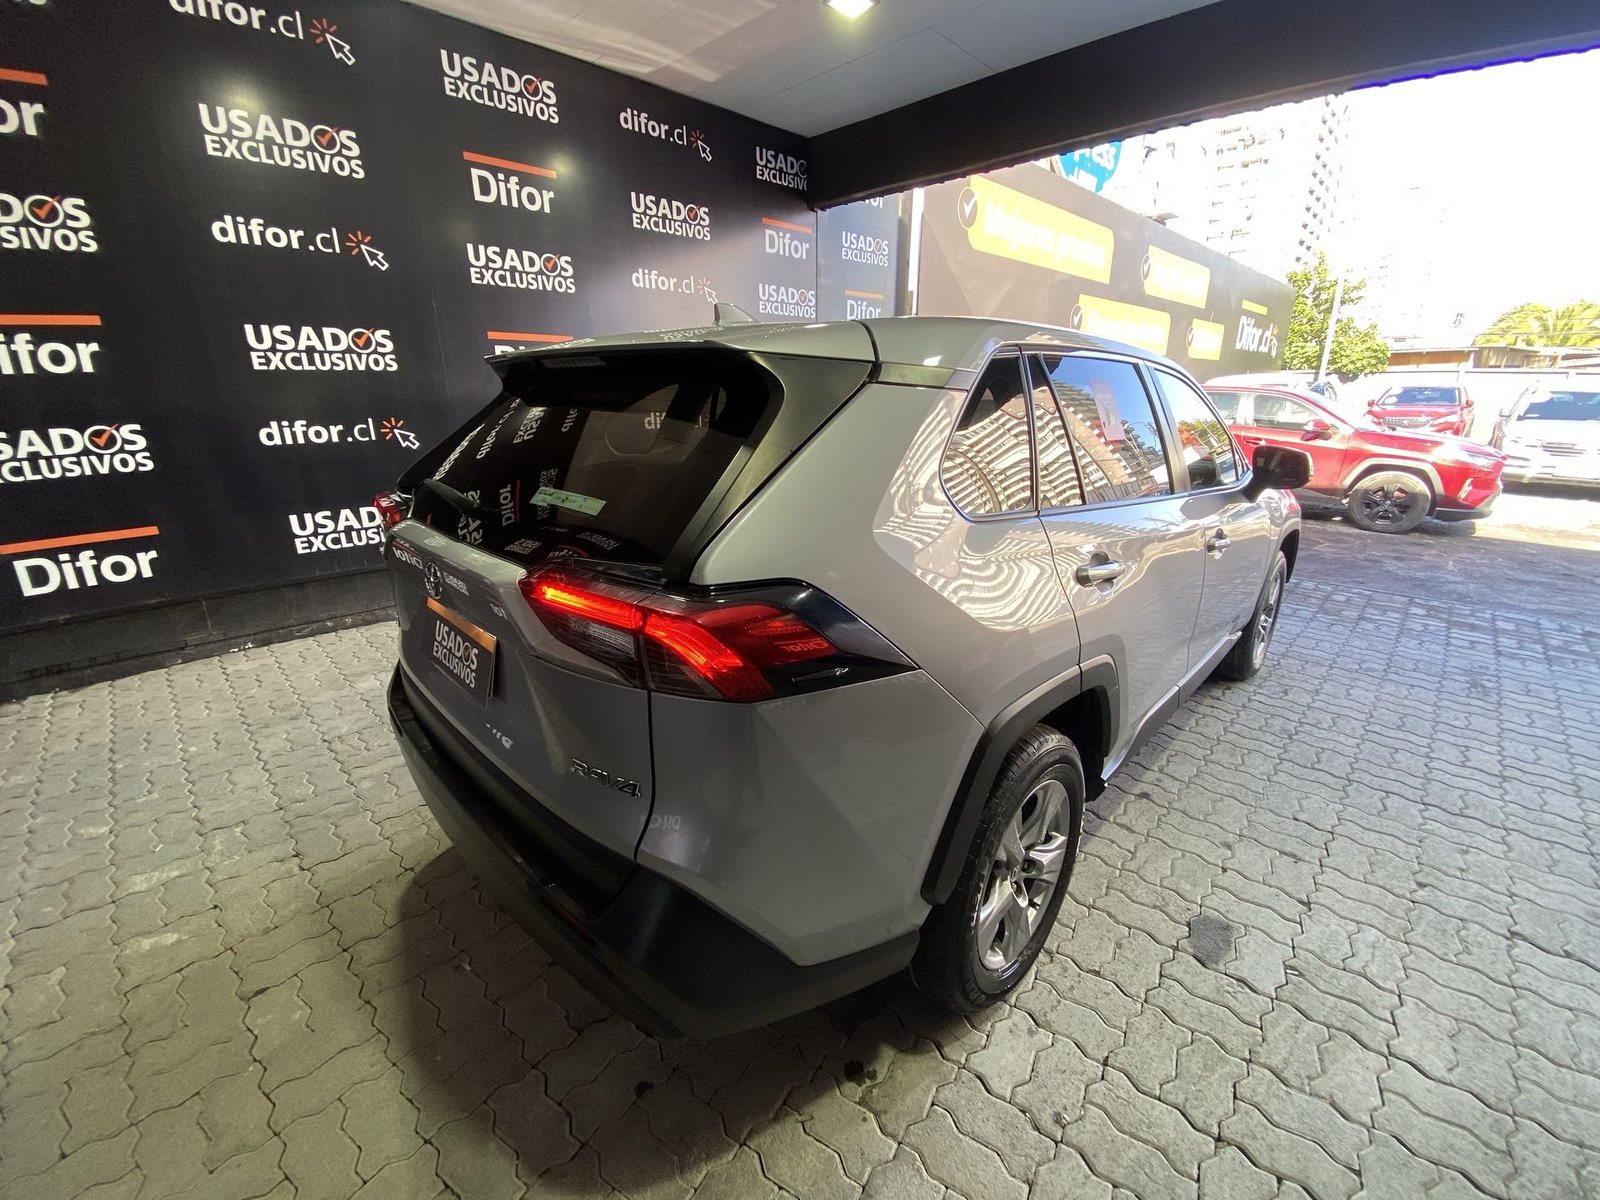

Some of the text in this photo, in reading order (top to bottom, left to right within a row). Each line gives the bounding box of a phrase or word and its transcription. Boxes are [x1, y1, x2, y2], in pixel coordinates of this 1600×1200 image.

[439, 48, 557, 104] USADOS
[444, 77, 559, 124] EXCLUSIVOS
[198, 103, 361, 157] USADOS
[619, 108, 688, 146] difor.cl
[204, 134, 365, 179] EXCLUSIVOS
[470, 167, 555, 213] Difor
[630, 191, 710, 226] USADOS
[211, 215, 341, 254] difor.cl
[632, 213, 711, 241] EXCLUSIVOS
[842, 231, 888, 255] USADOS
[466, 243, 573, 277] USADOS
[765, 229, 809, 260] Difor
[842, 249, 888, 267] EXCLUSIVOS
[469, 266, 576, 294] EXCLUSIVOS
[631, 268, 694, 294] difor.cl
[758, 283, 816, 306] USADOS
[759, 302, 816, 319] EXCLUSIVOS
[846, 300, 881, 319] Difor
[244, 324, 394, 353] USADOS
[250, 351, 398, 371] EXCLUSIVOS
[258, 418, 376, 446] difor.cl
[0, 451, 154, 484] CLUSIVOS
[13, 549, 158, 597] Difor
[435, 620, 479, 671] USADOS
[432, 644, 476, 689] EXCLUSIVOS
[570, 757, 642, 799] RAV4
